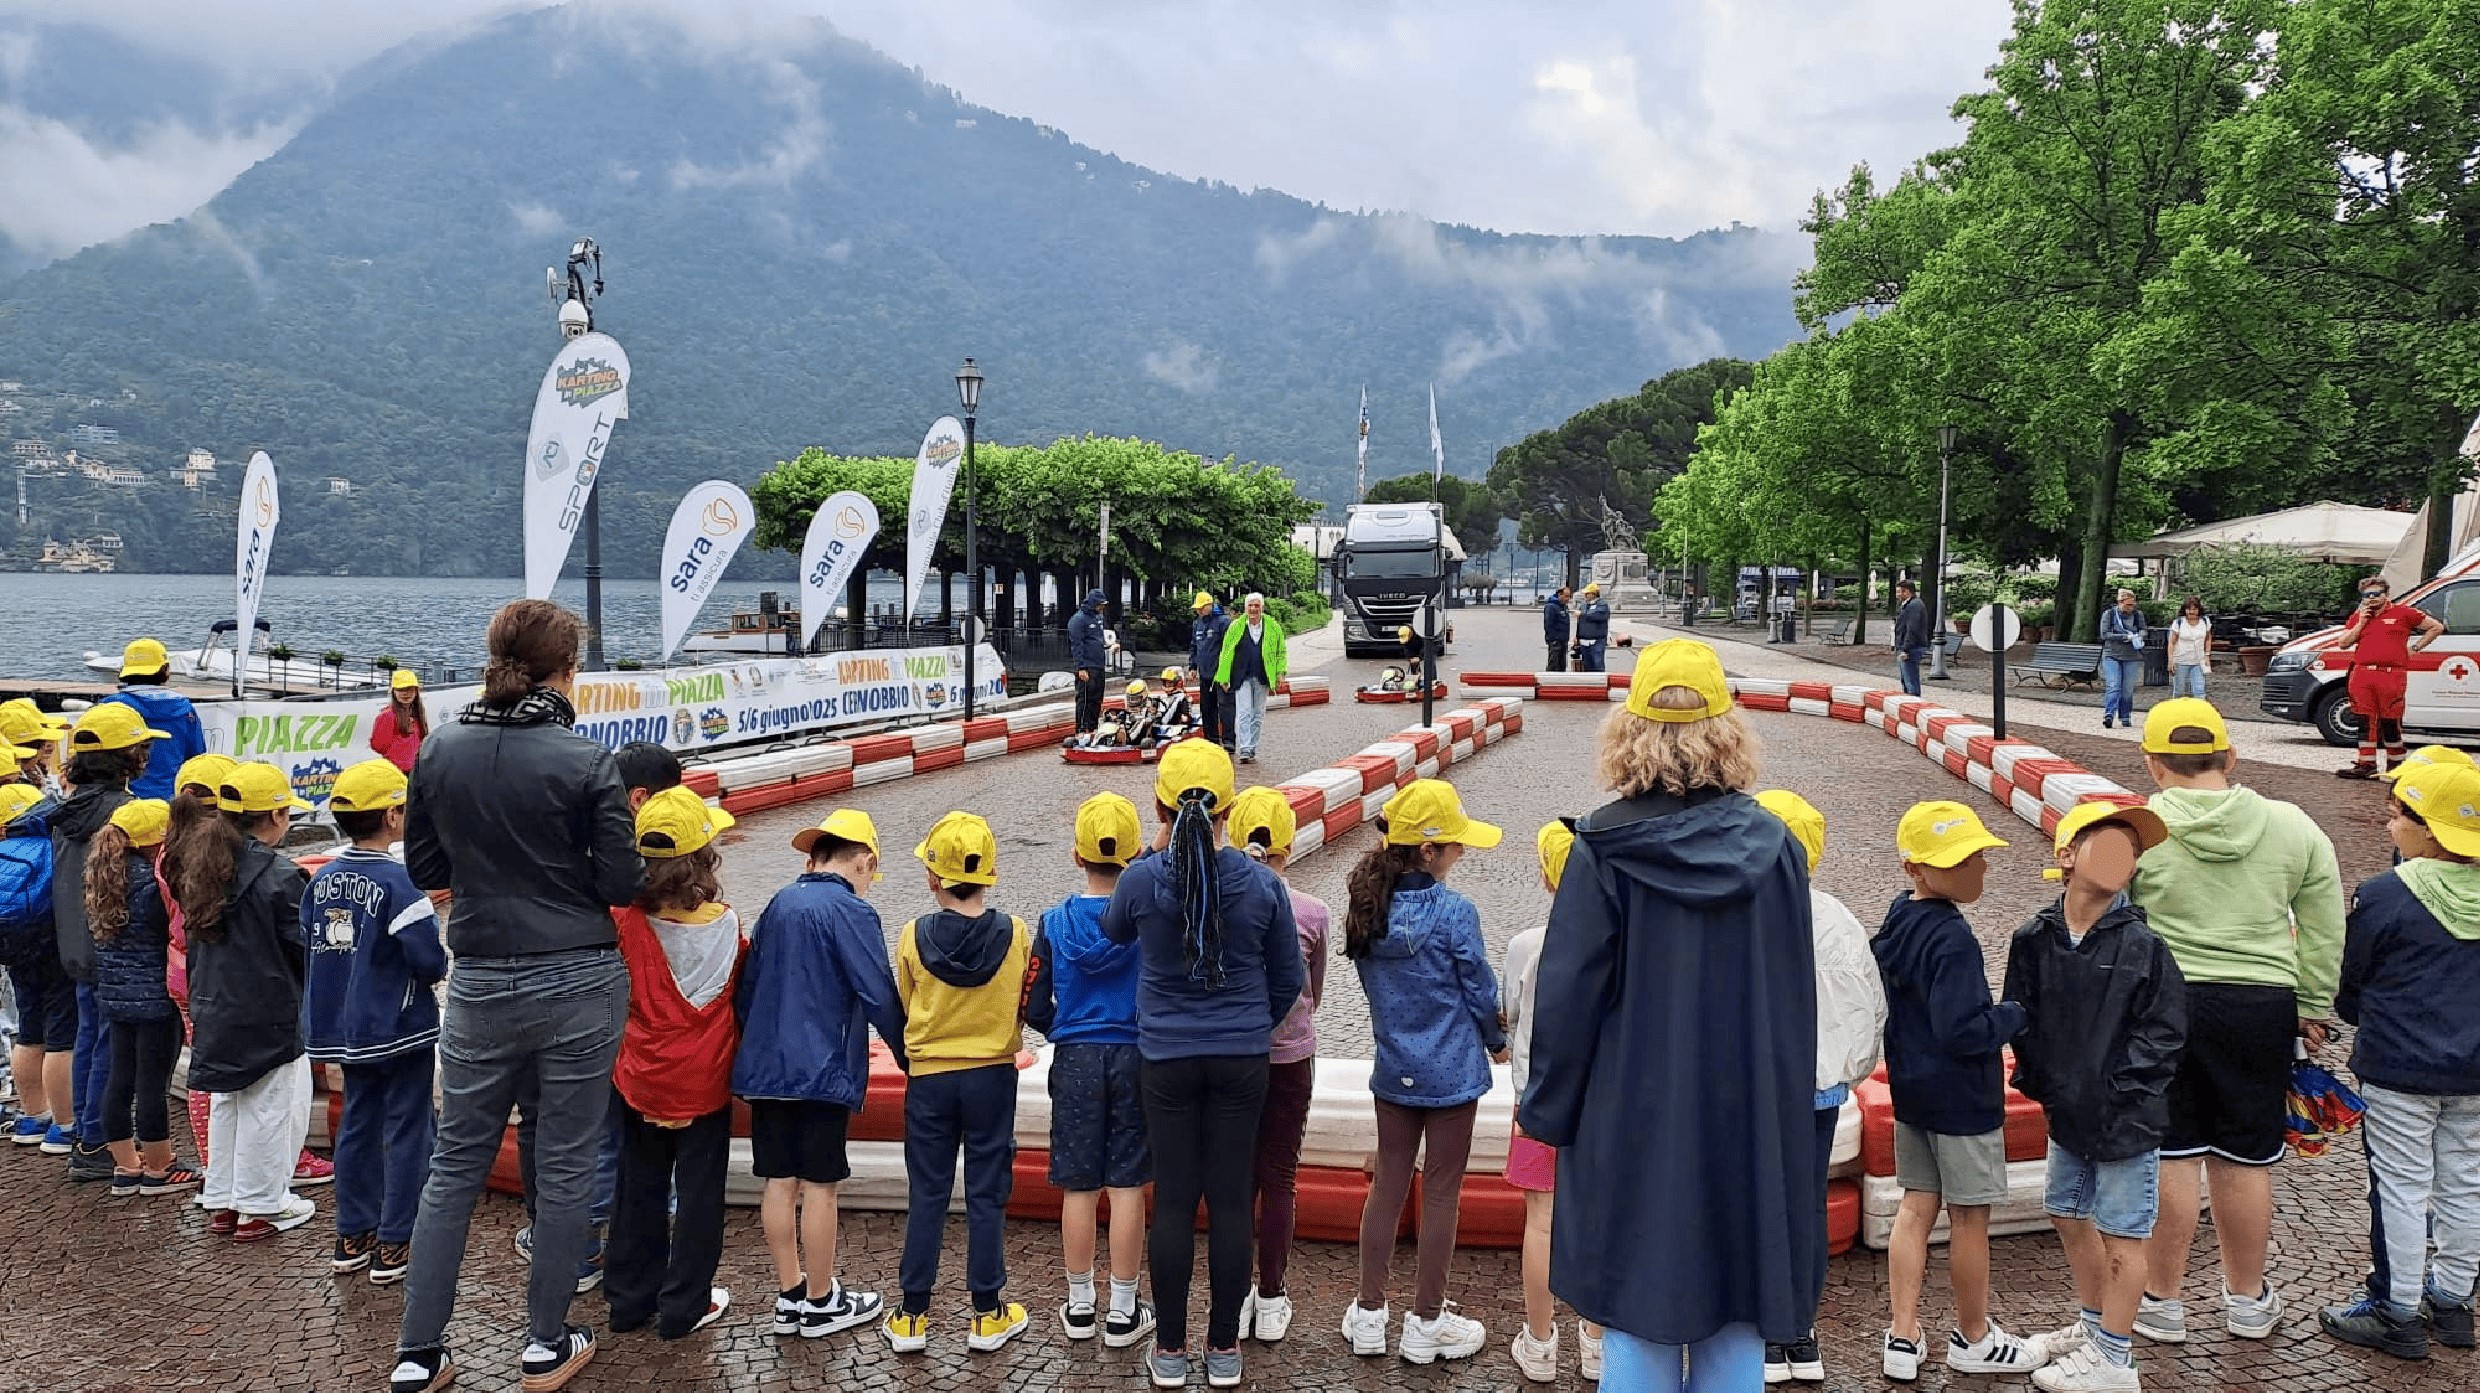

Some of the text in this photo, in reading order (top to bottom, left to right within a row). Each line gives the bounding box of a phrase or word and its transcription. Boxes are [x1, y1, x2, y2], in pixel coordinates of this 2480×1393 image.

[557, 370, 618, 389] KARTING
[574, 380, 621, 397] PIAZZA
[559, 412, 610, 533] SPORT
[671, 536, 713, 593] sara
[810, 540, 844, 588] sara
[838, 658, 889, 685] KARTING
[568, 682, 641, 715] RTING
[666, 672, 725, 707] PIAZZA
[233, 713, 358, 757] PIAZZA
[575, 715, 668, 751] NOBBIO
[738, 707, 759, 732] 5/6
[760, 704, 810, 734] giugno
[291, 773, 337, 786] KARTIN
[314, 872, 384, 918] OSTON
